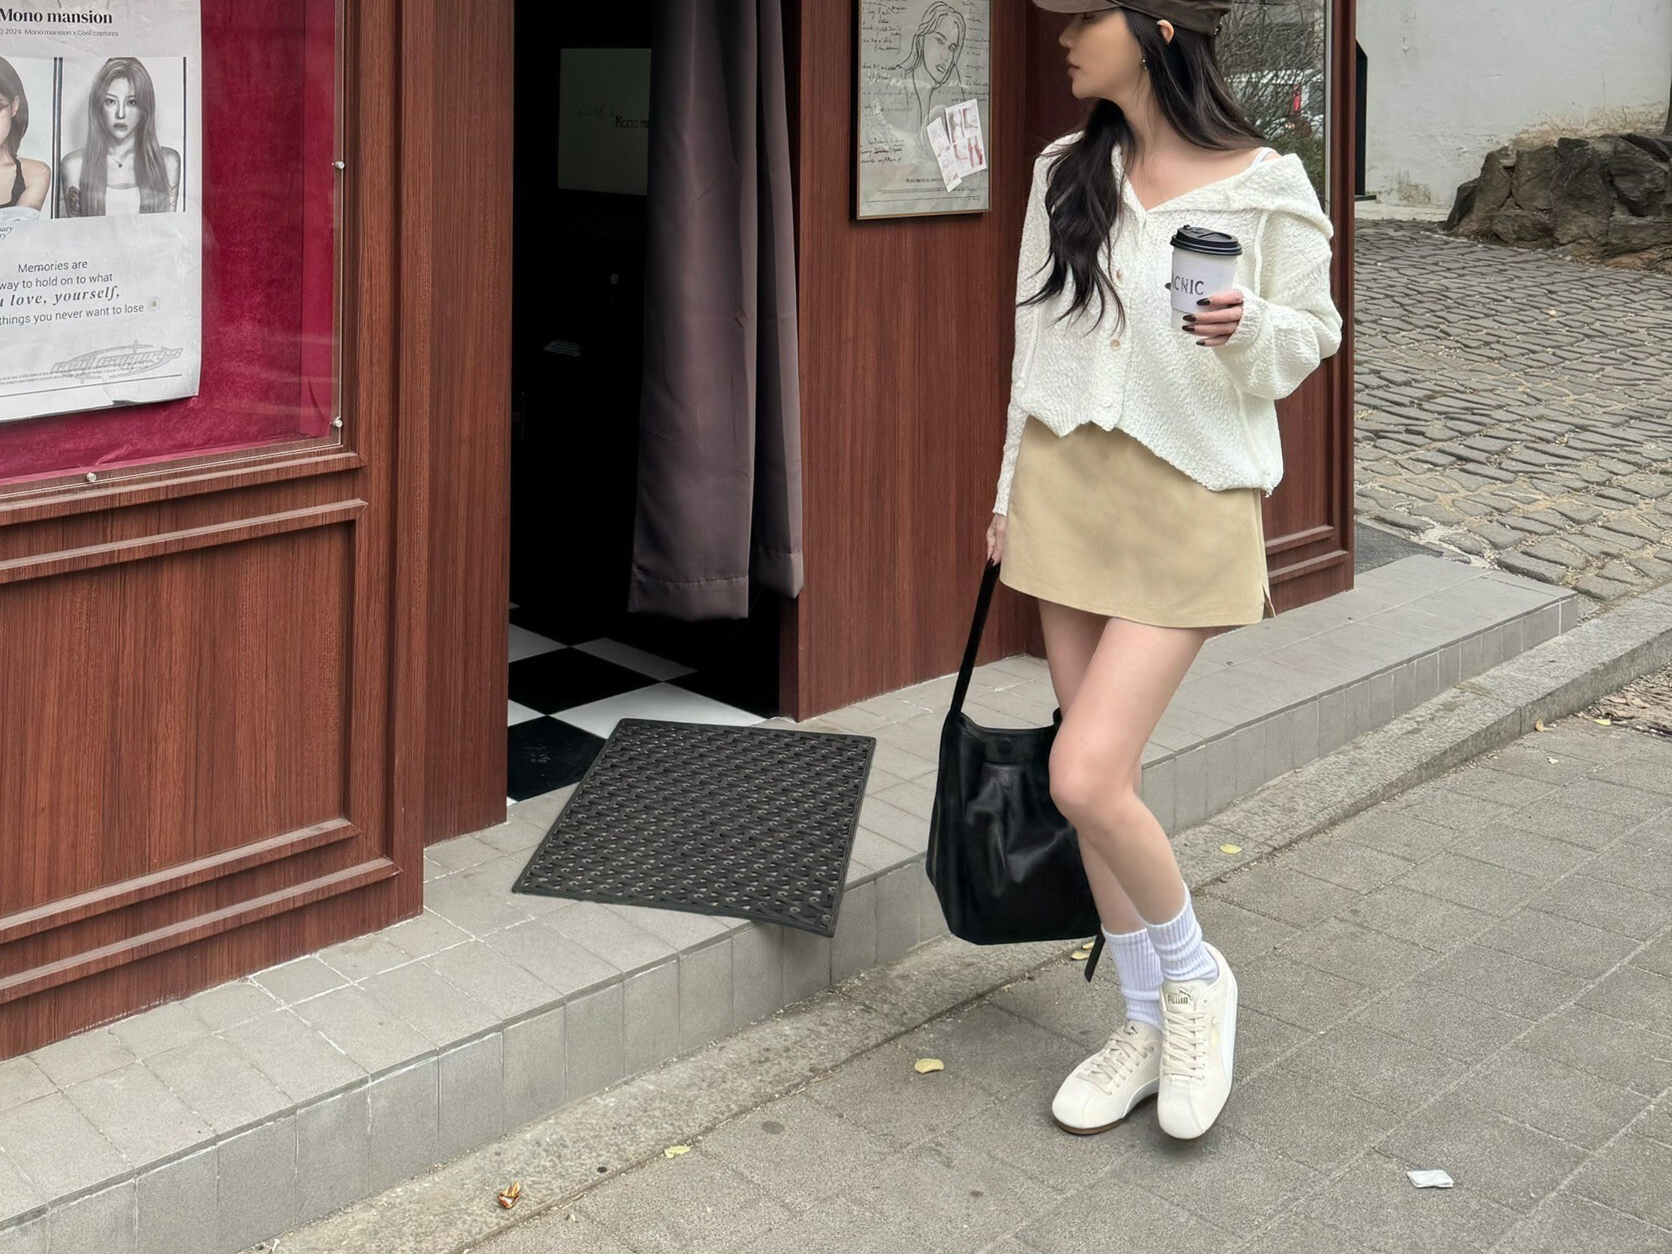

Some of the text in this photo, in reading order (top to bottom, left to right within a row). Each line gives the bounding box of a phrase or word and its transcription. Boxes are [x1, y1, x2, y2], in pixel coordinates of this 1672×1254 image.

[0, 8, 113, 24] Mono mansion
[92, 30, 119, 38] captures
[18, 260, 88, 273] Memories are
[22, 280, 33, 288] to
[35, 276, 58, 288] hold
[60, 277, 73, 286] on
[76, 276, 86, 284] to
[89, 272, 113, 283] what
[10, 294, 47, 306] love,
[53, 285, 120, 305] yourself,
[33, 313, 53, 324] you
[55, 310, 83, 321] never
[86, 307, 109, 317] want
[112, 306, 122, 315] to
[124, 304, 144, 314] lose
